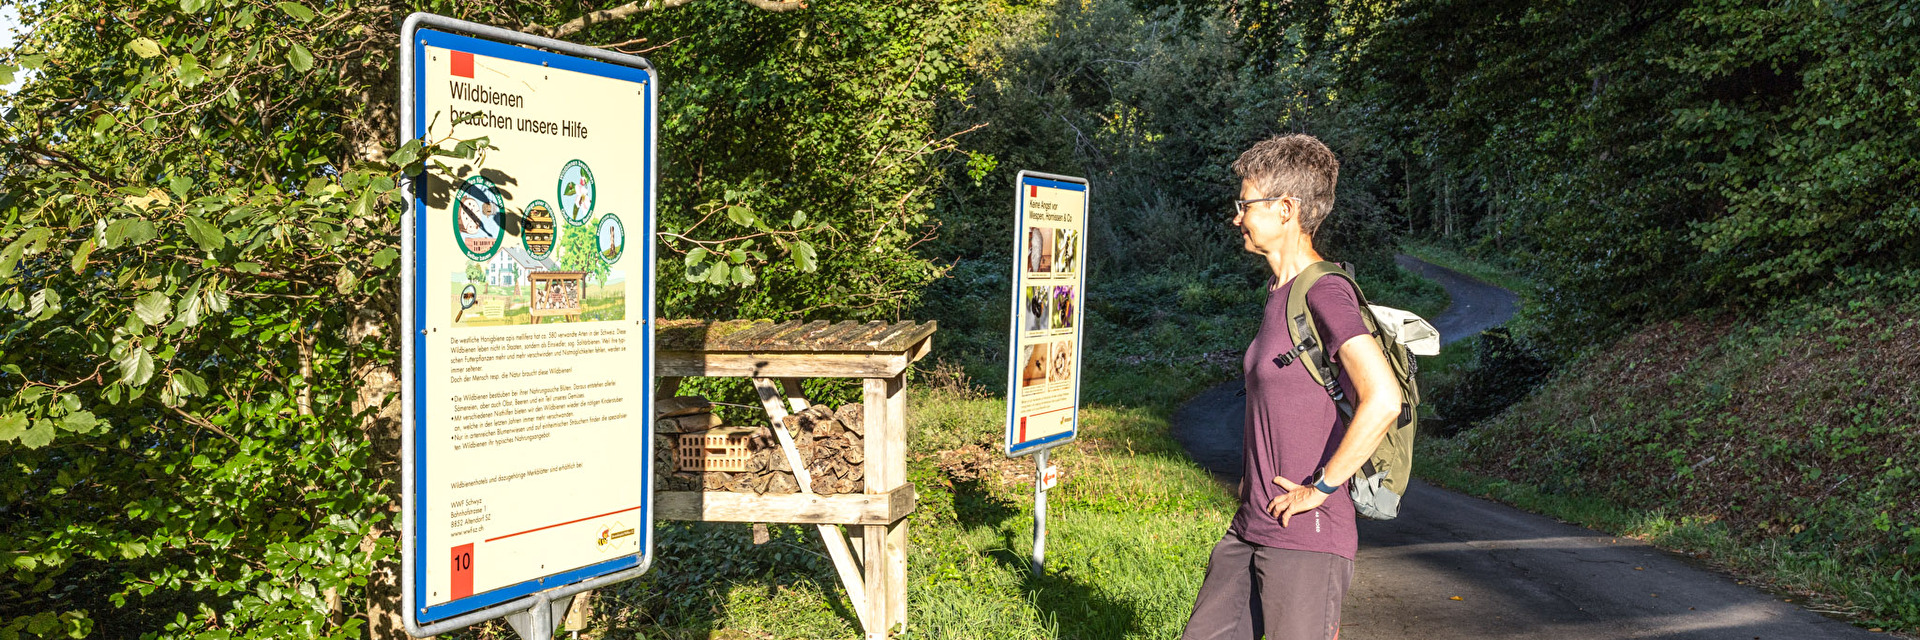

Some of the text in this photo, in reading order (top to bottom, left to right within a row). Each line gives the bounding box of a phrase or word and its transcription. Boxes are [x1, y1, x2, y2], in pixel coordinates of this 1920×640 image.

[450, 80, 524, 108] Wildbienen
[450, 104, 588, 139] brauchen unsere Hilfe
[454, 552, 470, 572] 10
